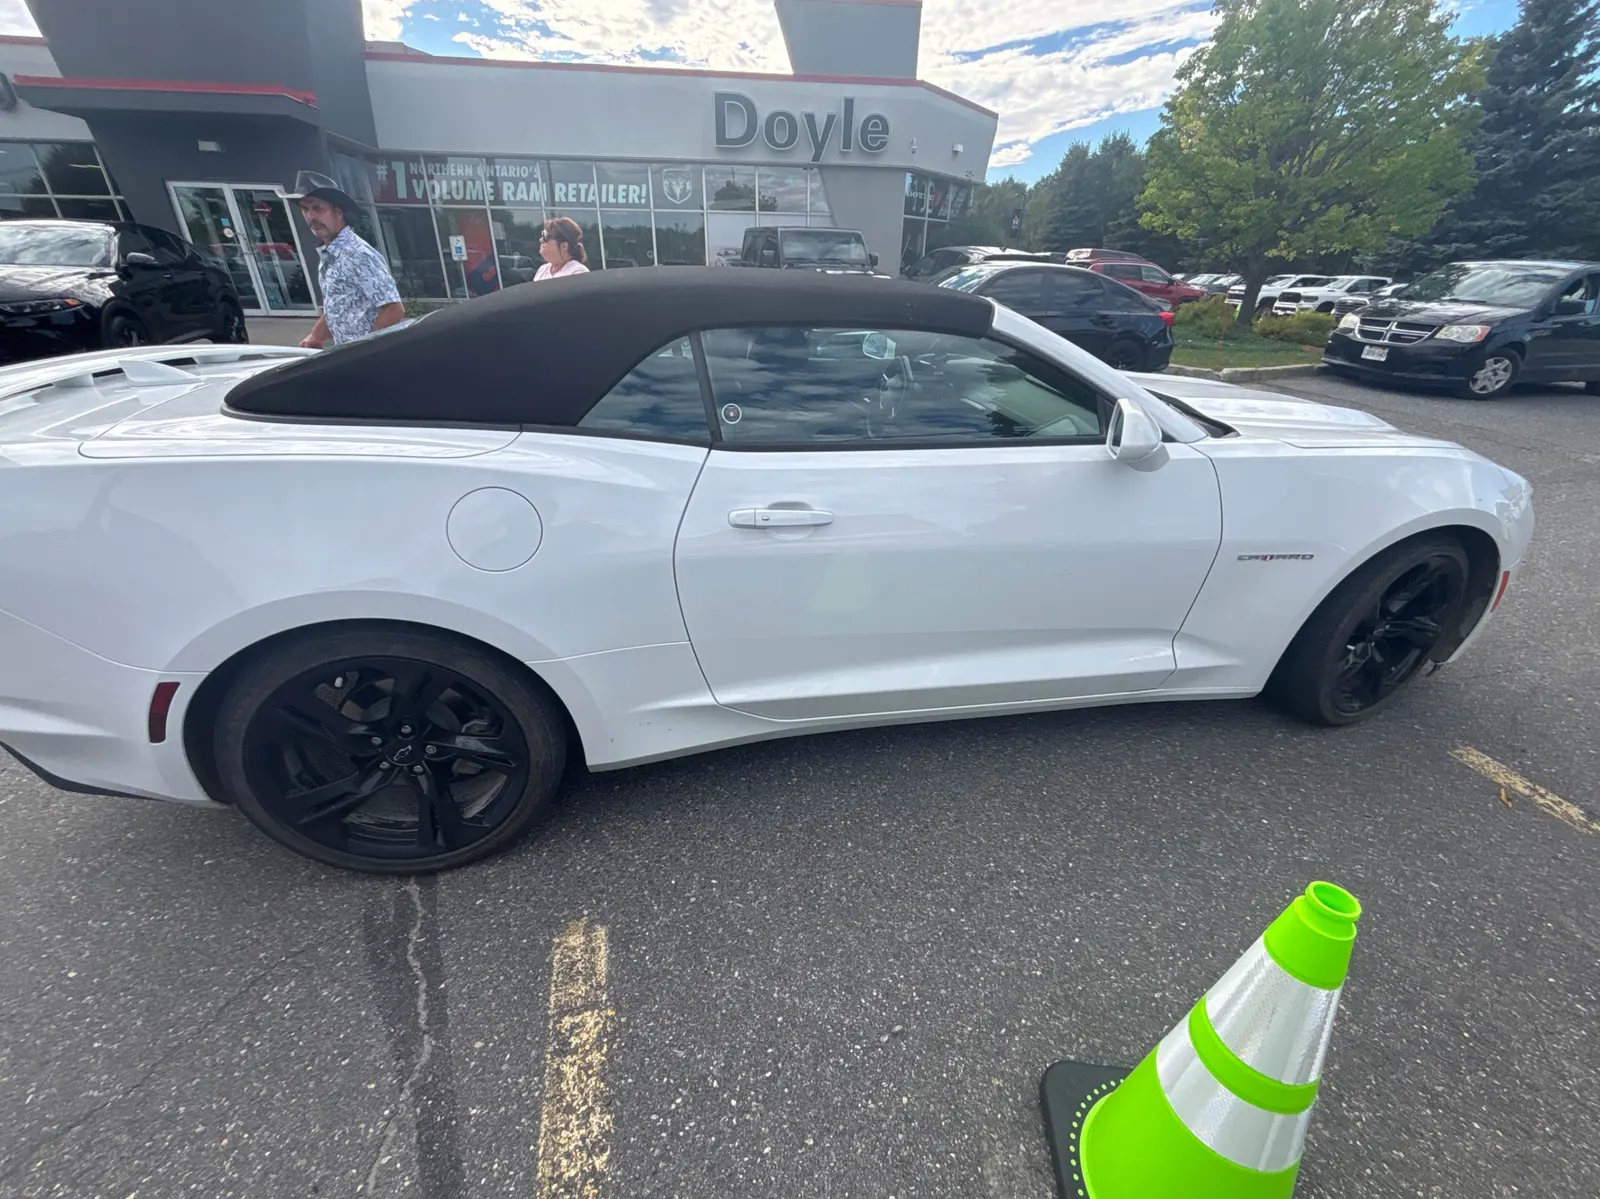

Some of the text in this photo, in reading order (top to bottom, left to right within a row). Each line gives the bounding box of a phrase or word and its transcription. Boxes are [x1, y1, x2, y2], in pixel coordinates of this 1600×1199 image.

[713, 91, 890, 163] Doyle
[375, 159, 408, 199] #1
[409, 162, 474, 177] NORTHERN
[411, 178, 647, 204] VOLUME RAM RETAILER!
